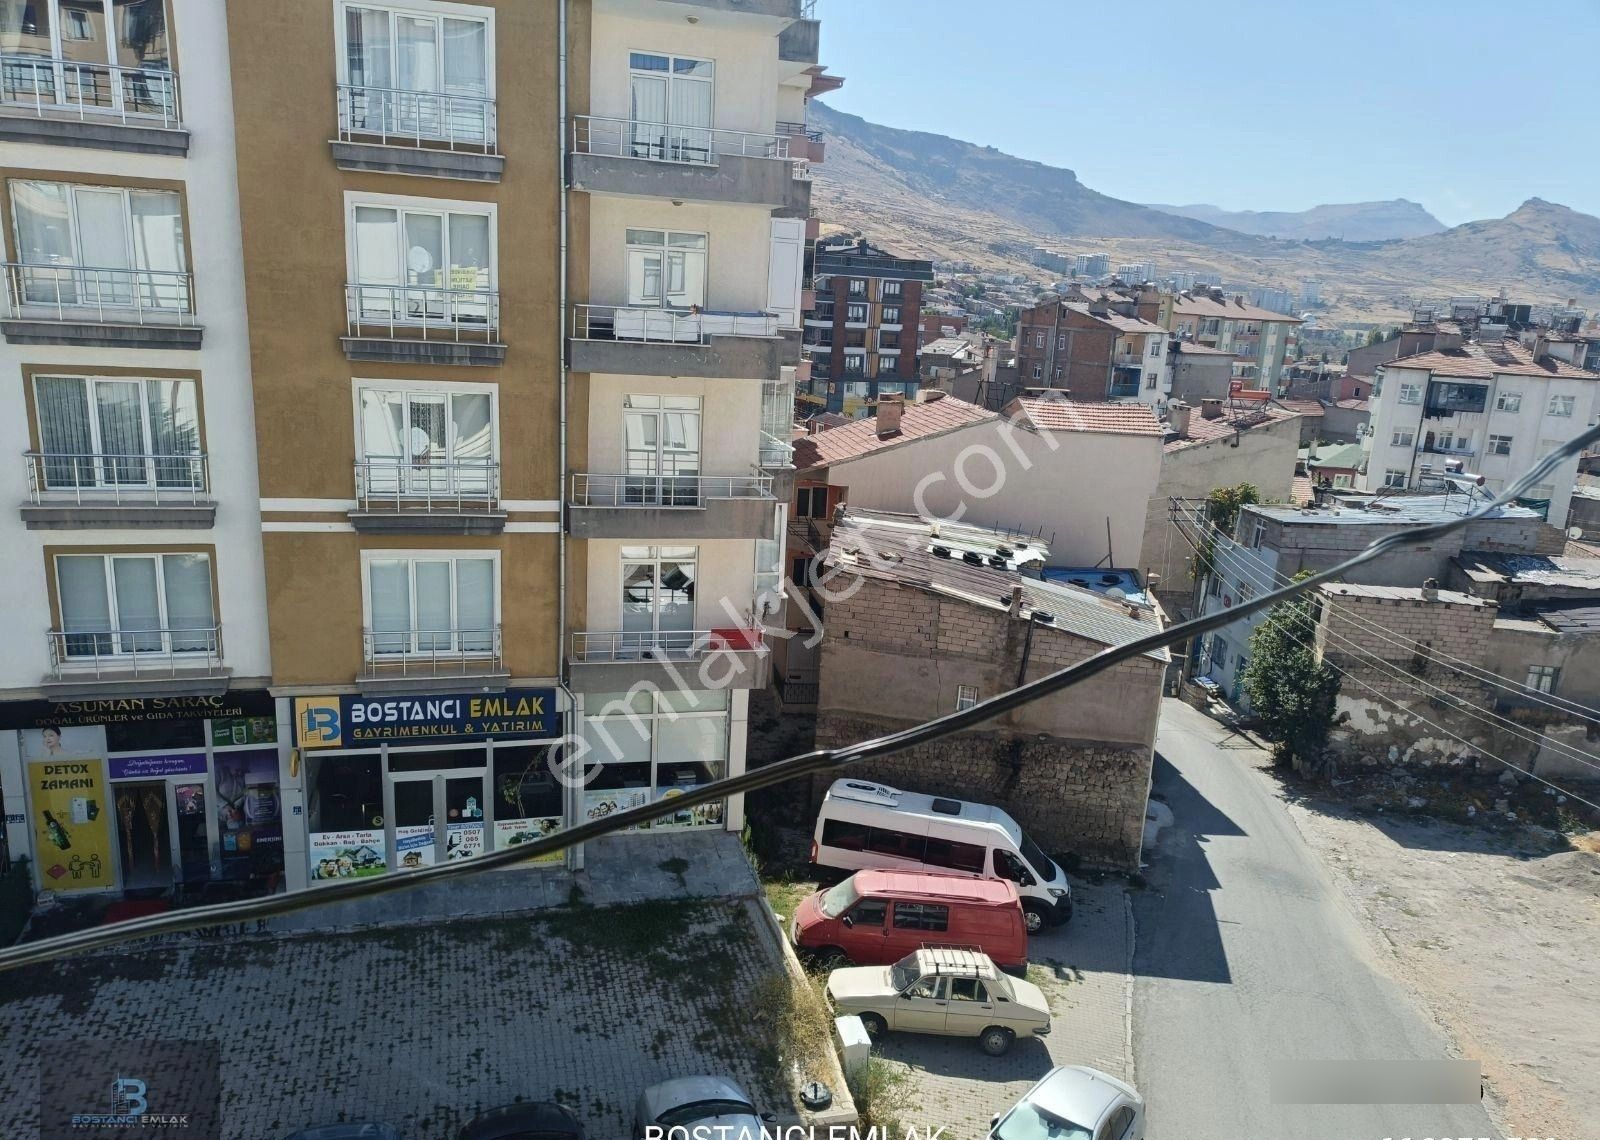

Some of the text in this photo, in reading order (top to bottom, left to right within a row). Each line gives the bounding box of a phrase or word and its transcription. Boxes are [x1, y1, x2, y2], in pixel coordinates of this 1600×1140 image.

[54, 695, 224, 714] ASUMAN SARAÇ
[352, 696, 545, 723] BOSTANCI EMLAK
[35, 715, 76, 726] DOĞAL
[78, 714, 128, 725] ÜRÜNLER
[147, 711, 174, 720] GIDA
[353, 720, 543, 738] GAYRİMENKUL & YATIRIM
[44, 764, 89, 775] DETOX
[41, 778, 94, 790] ZAMANI
